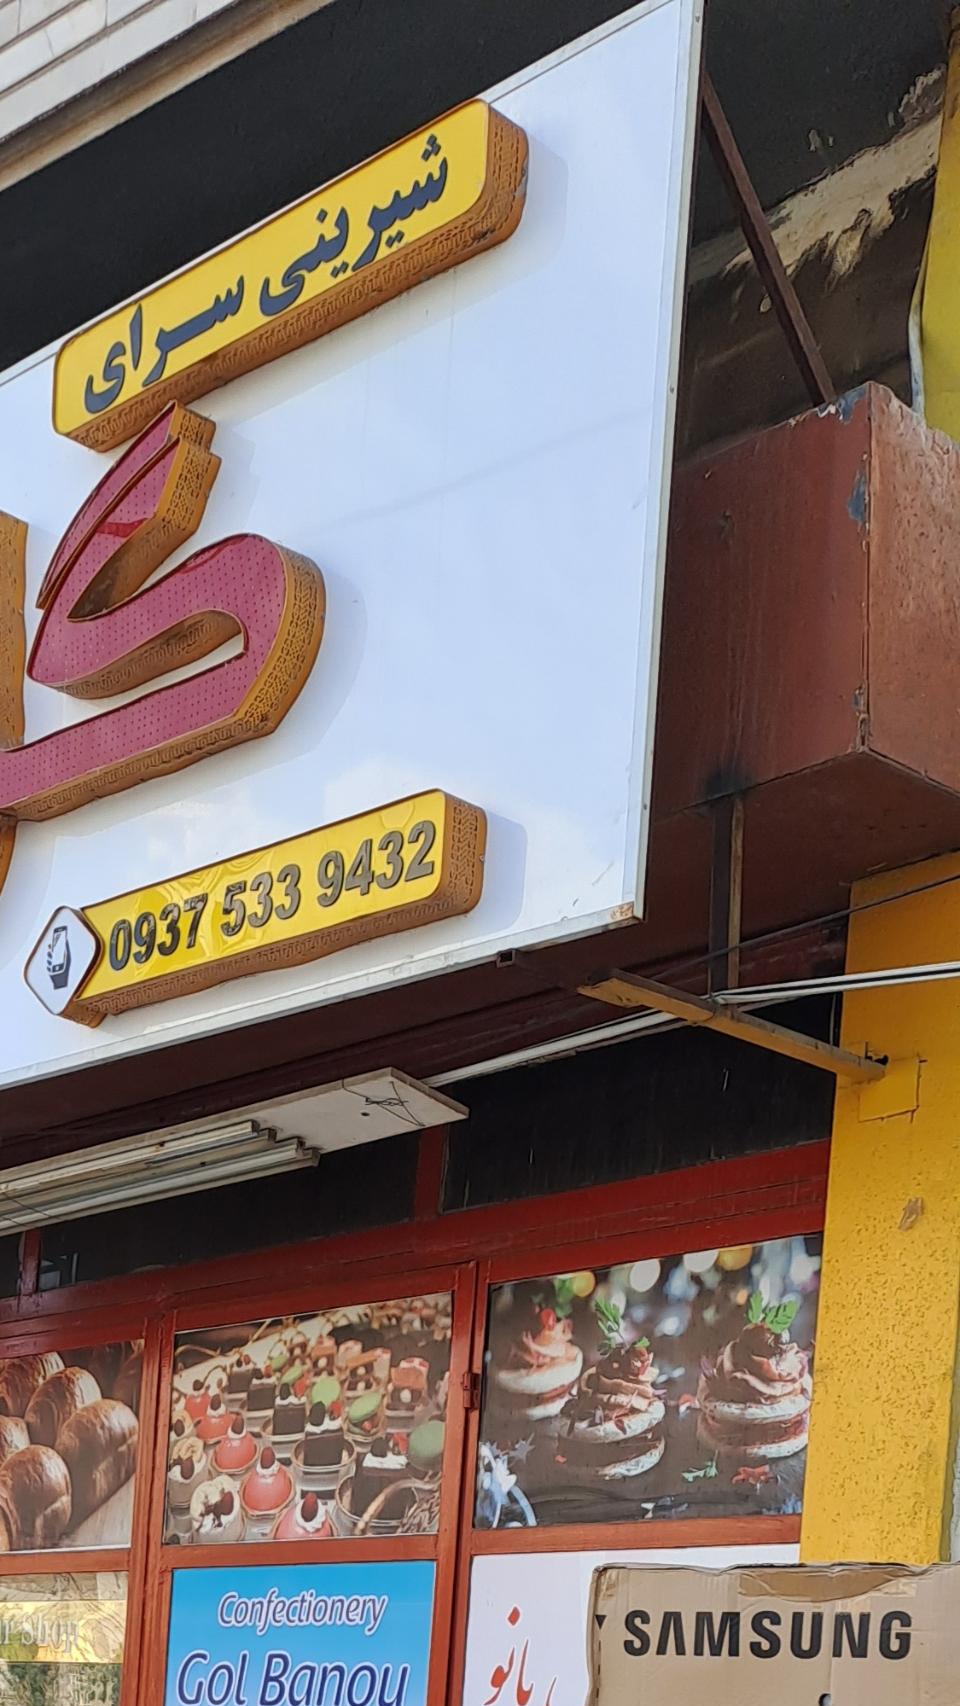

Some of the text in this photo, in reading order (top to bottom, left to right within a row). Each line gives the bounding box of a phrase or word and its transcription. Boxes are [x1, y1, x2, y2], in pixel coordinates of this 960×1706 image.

[84, 133, 448, 414] شیرینی سرای
[109, 821, 436, 971] 0937 533 9432
[21, 1611, 81, 1653] Shop
[220, 1589, 386, 1634] Confectionery
[624, 1609, 912, 1660] SAMSUNG
